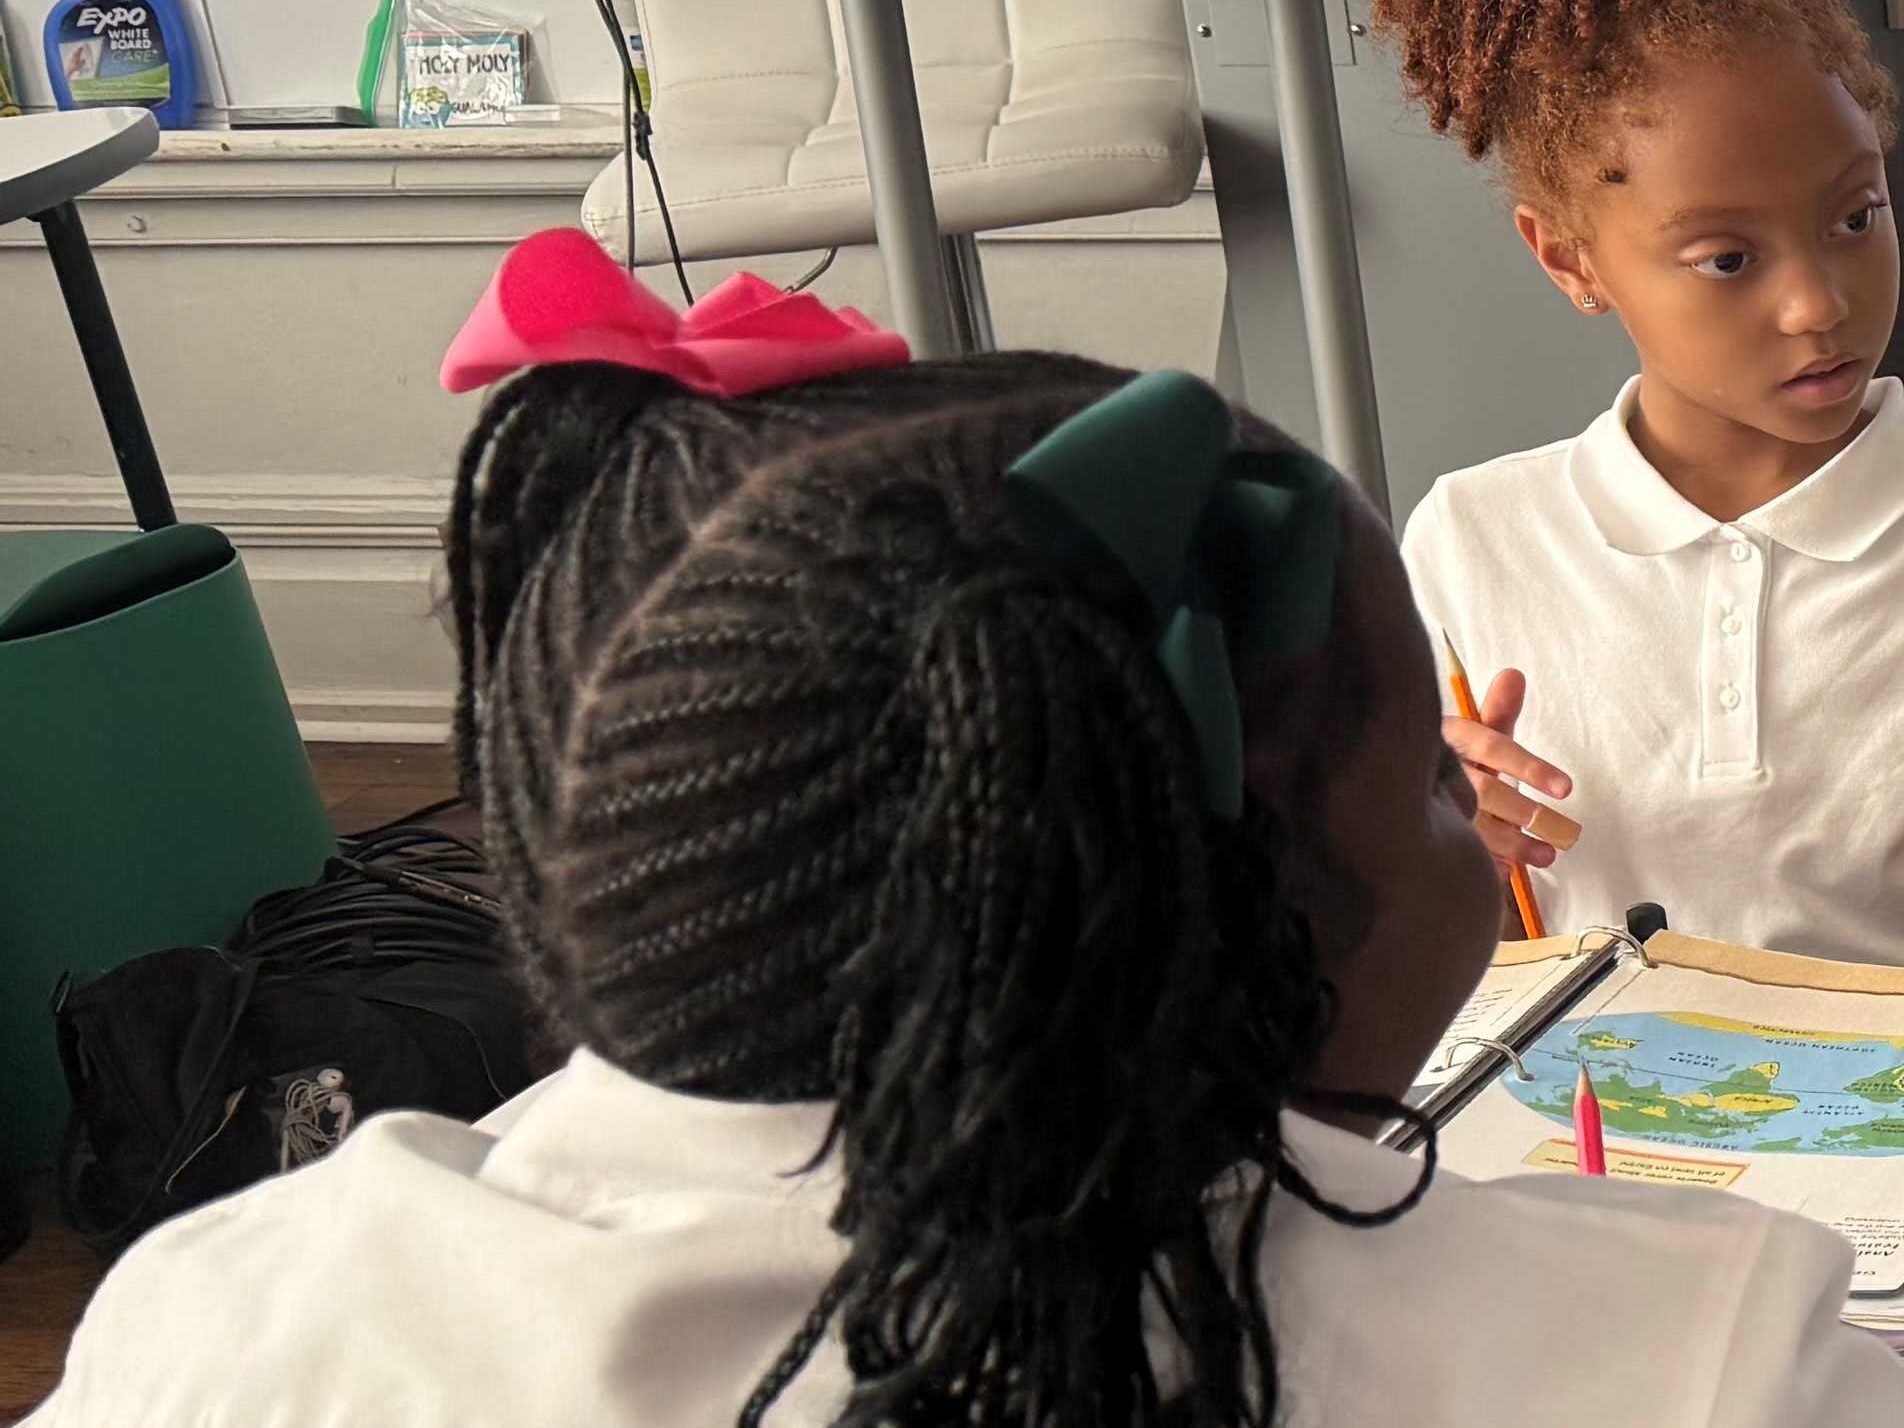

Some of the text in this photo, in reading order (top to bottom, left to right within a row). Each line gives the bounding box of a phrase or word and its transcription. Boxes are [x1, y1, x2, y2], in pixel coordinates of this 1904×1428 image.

[77, 7, 147, 34] EXPO
[108, 28, 150, 40] WHITE
[110, 39, 152, 50] BOARD
[467, 53, 510, 74] MOLY
